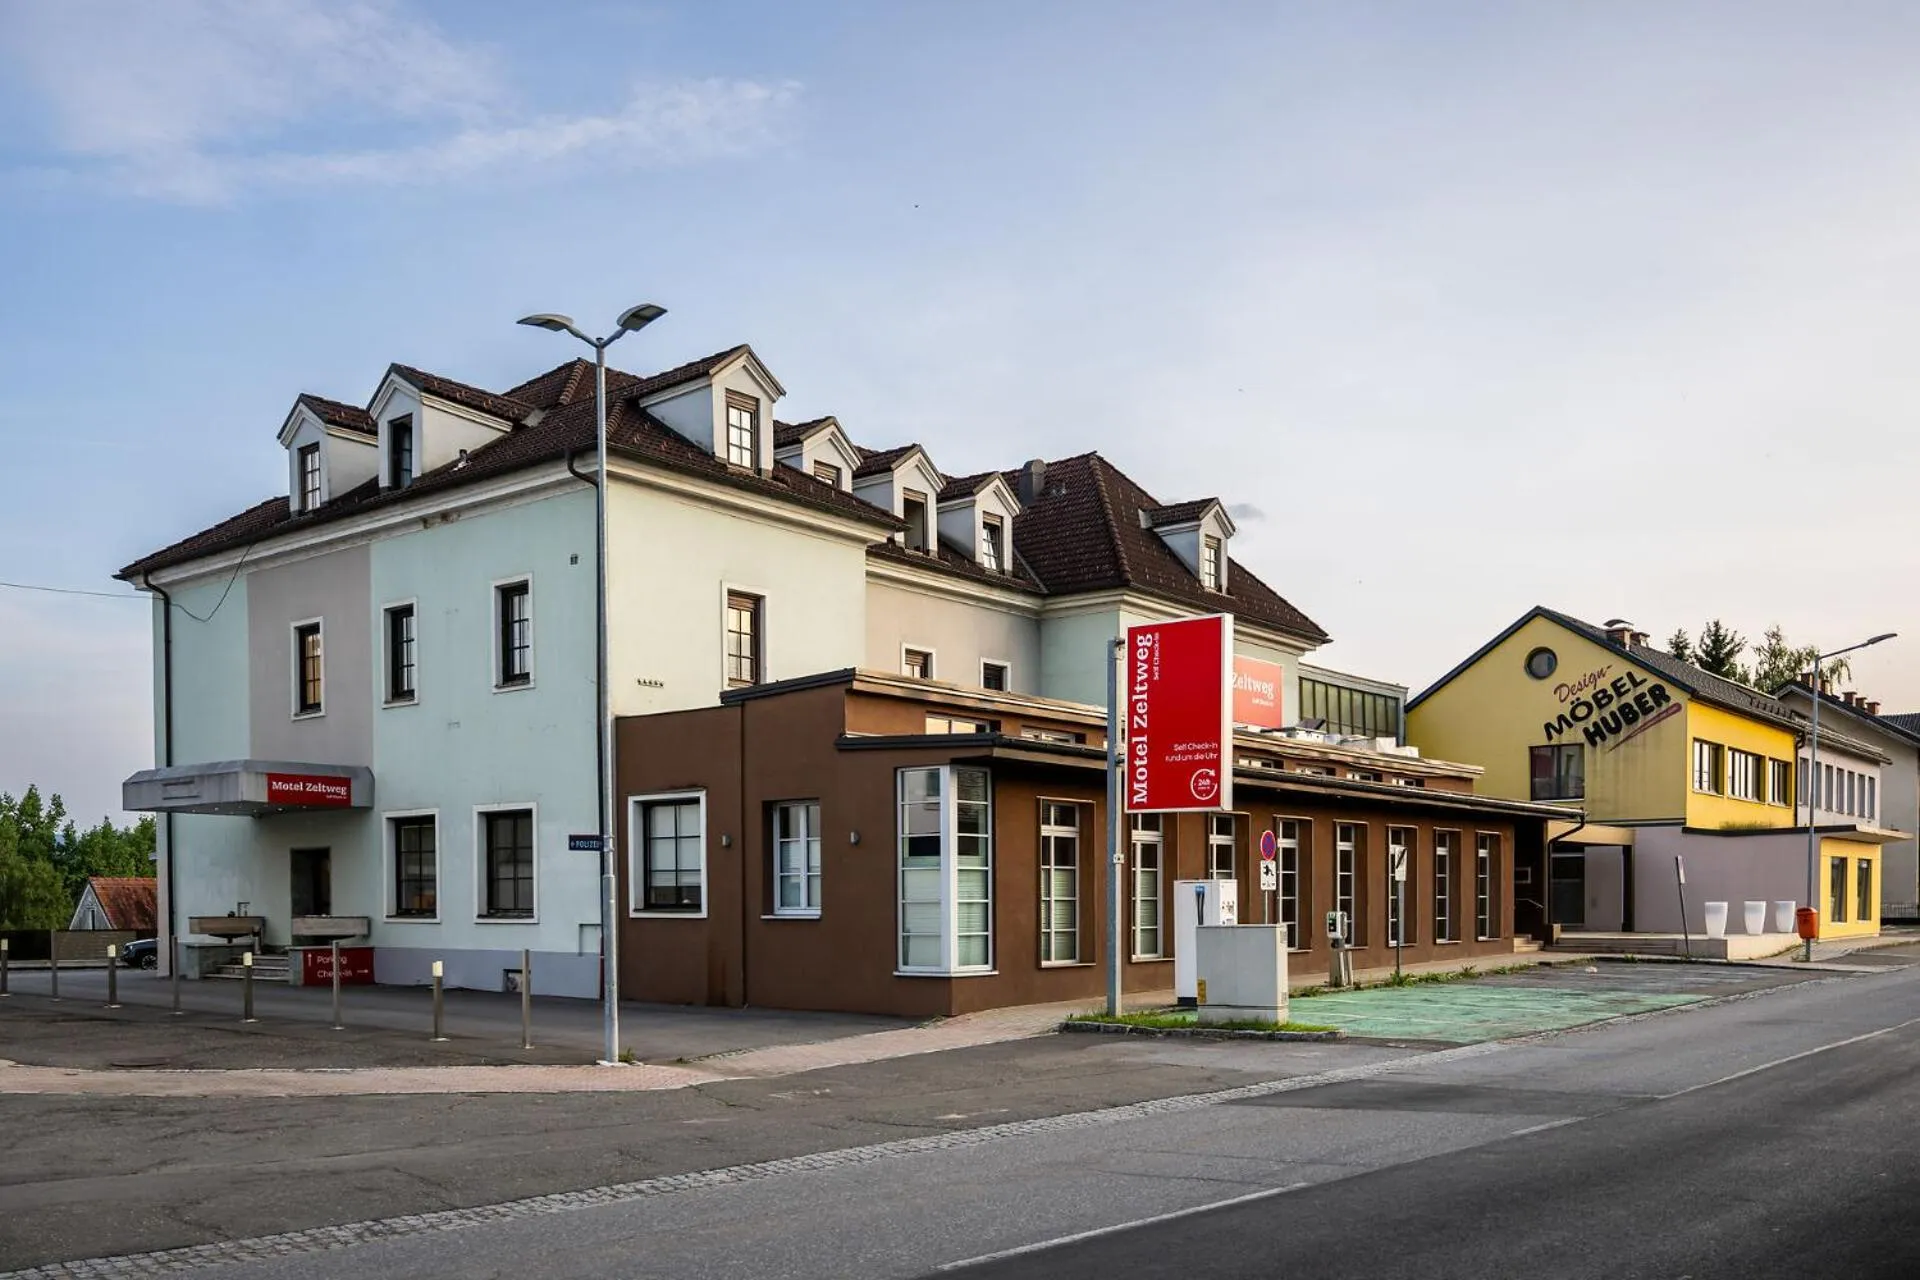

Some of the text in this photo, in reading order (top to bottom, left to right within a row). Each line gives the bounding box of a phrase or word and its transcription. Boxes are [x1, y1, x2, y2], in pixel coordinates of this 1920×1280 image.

[1132, 633, 1153, 804] Motel Zeltweg
[1543, 671, 1648, 742] MÖBEL
[1582, 683, 1671, 748] HUBER
[1173, 742, 1218, 751] Self Check-in
[1205, 751, 1218, 760] Uhr
[272, 782, 347, 795] Motel Zeltweg
